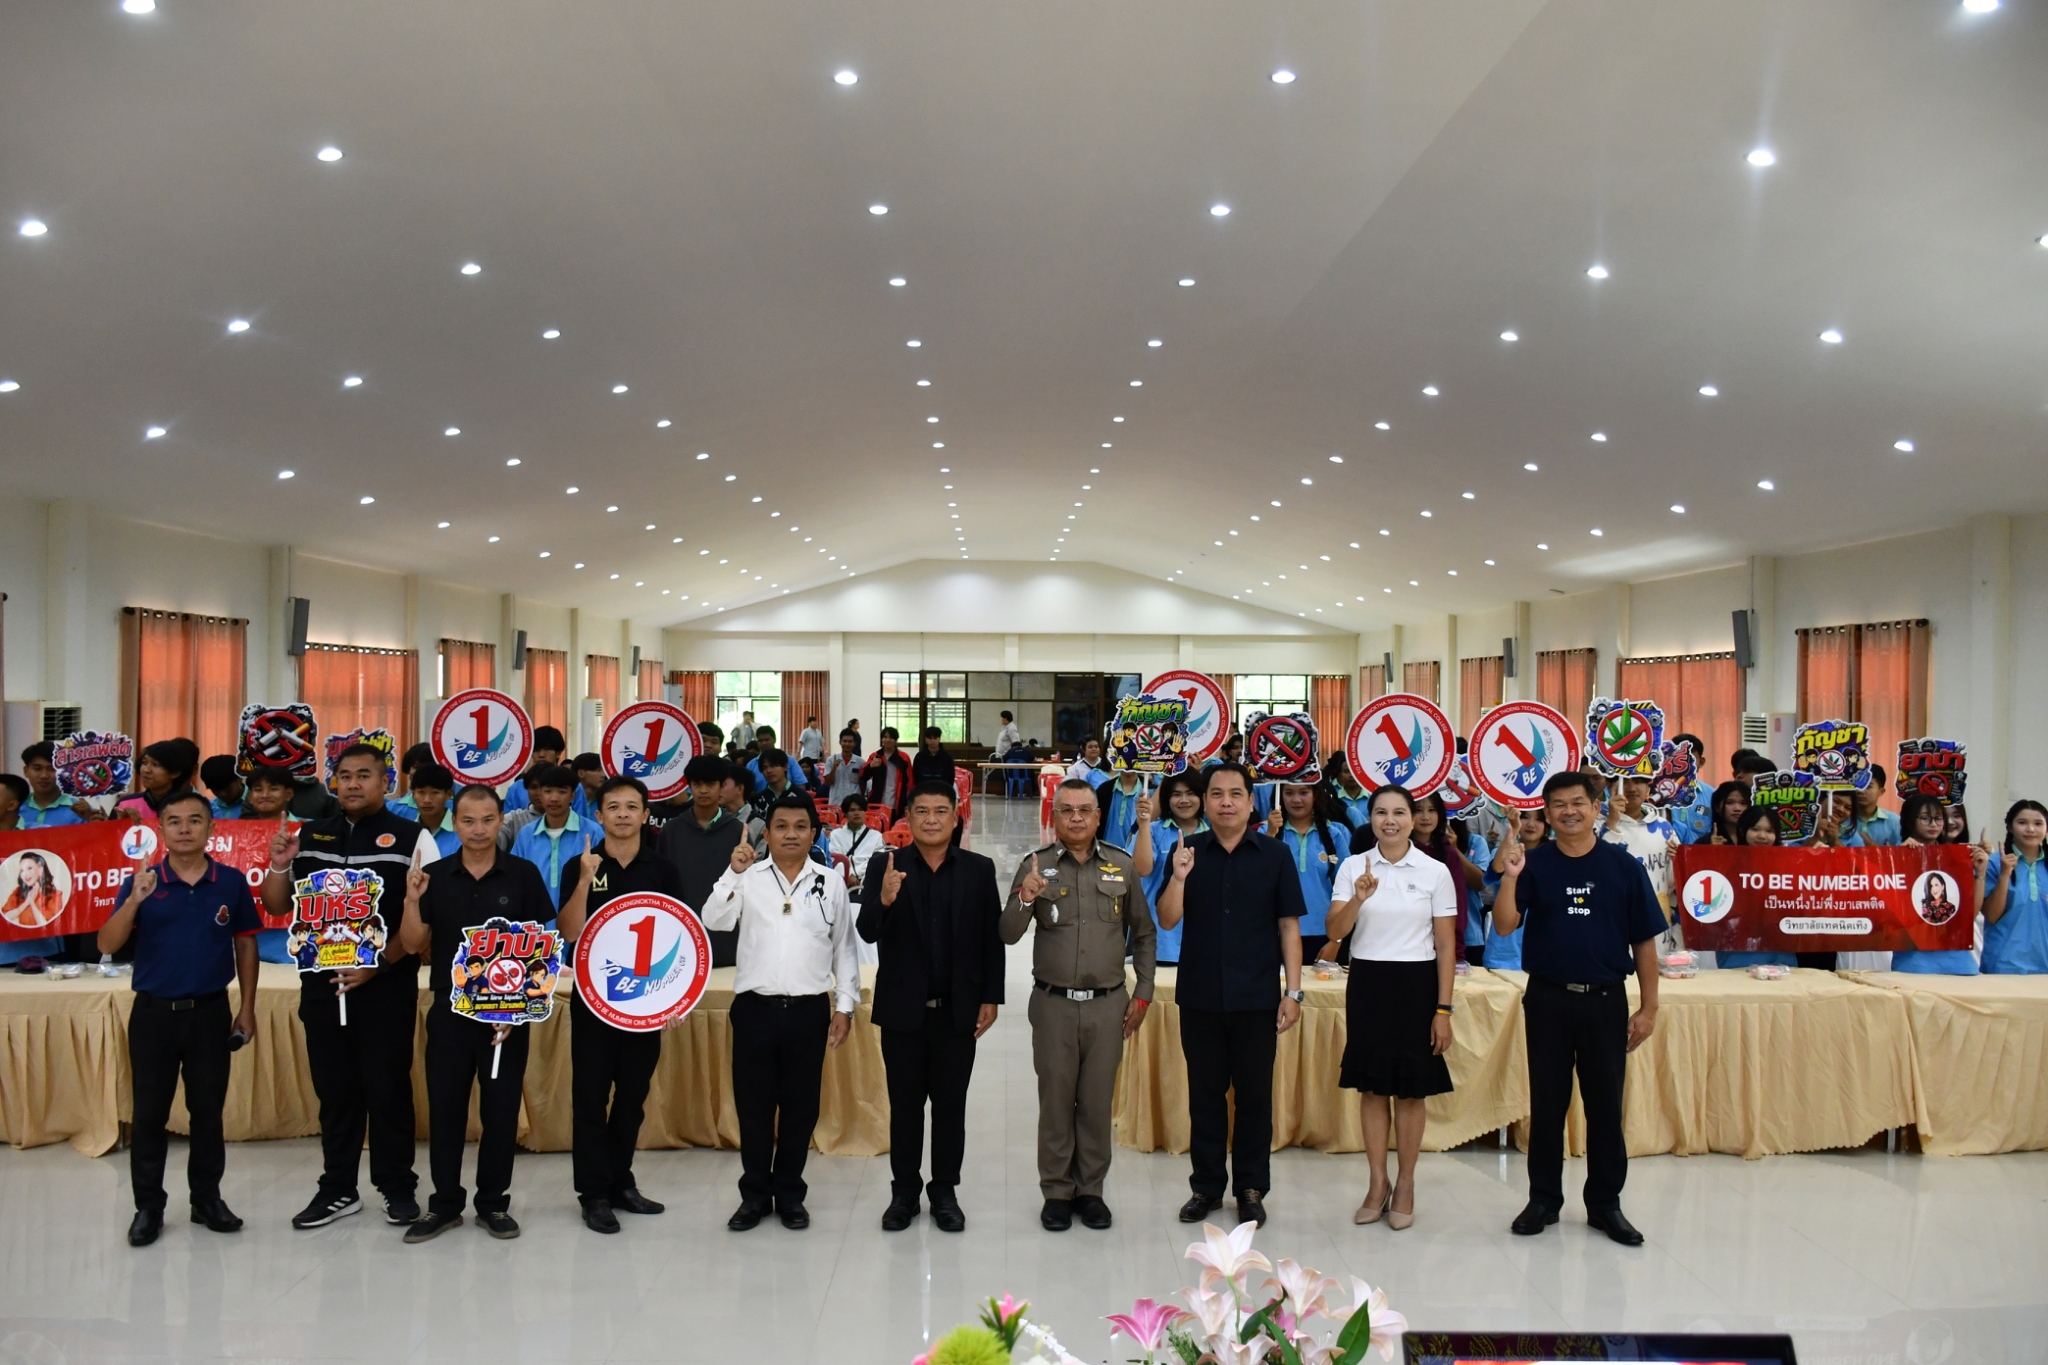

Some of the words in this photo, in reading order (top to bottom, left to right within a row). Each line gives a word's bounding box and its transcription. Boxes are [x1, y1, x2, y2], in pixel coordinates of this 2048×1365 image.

[1121, 698, 1183, 724] กัญชา
[470, 705, 489, 750] 1
[1375, 713, 1412, 760] 1
[644, 718, 665, 763] 1
[1494, 724, 1537, 768] 1
[1798, 727, 1865, 755] กัญชา
[56, 740, 130, 766] สารเสพติด
[463, 750, 482, 763] BE
[1900, 749, 1964, 770] ยาบ้า
[629, 760, 649, 772] BE
[1394, 761, 1408, 778] BE
[1522, 767, 1537, 787] BE
[1756, 785, 1815, 805] กัญชา
[134, 829, 142, 848] 1
[74, 871, 102, 891] TO
[593, 873, 607, 887] M
[1739, 873, 1764, 890] TO
[1769, 874, 1793, 890] BE
[1798, 875, 1869, 891] NUMBER
[1873, 874, 1907, 890] ONE
[1566, 887, 1591, 895] Start
[1700, 876, 1712, 905] 1
[299, 881, 372, 930] บุหรี่
[1567, 906, 1590, 916] Stop
[1764, 894, 1885, 910] เป็นหนึ่งไม่พึ่งยาเสพติด
[581, 951, 587, 960] TO
[587, 917, 604, 942] NUMBER
[603, 908, 616, 919] ONE
[616, 898, 660, 911] LOENGNOKTHA
[662, 902, 684, 918] THOENG
[684, 916, 703, 946] TECHNICAL
[1785, 920, 1868, 930] วิทยาลัยเทคนิคเทิง
[469, 924, 554, 958] ยาบ้า
[629, 915, 656, 977] 1
[615, 977, 641, 994] BE
[594, 999, 602, 1009] TO
[600, 1007, 608, 1015] BE
[608, 1012, 633, 1025] NUMBER
